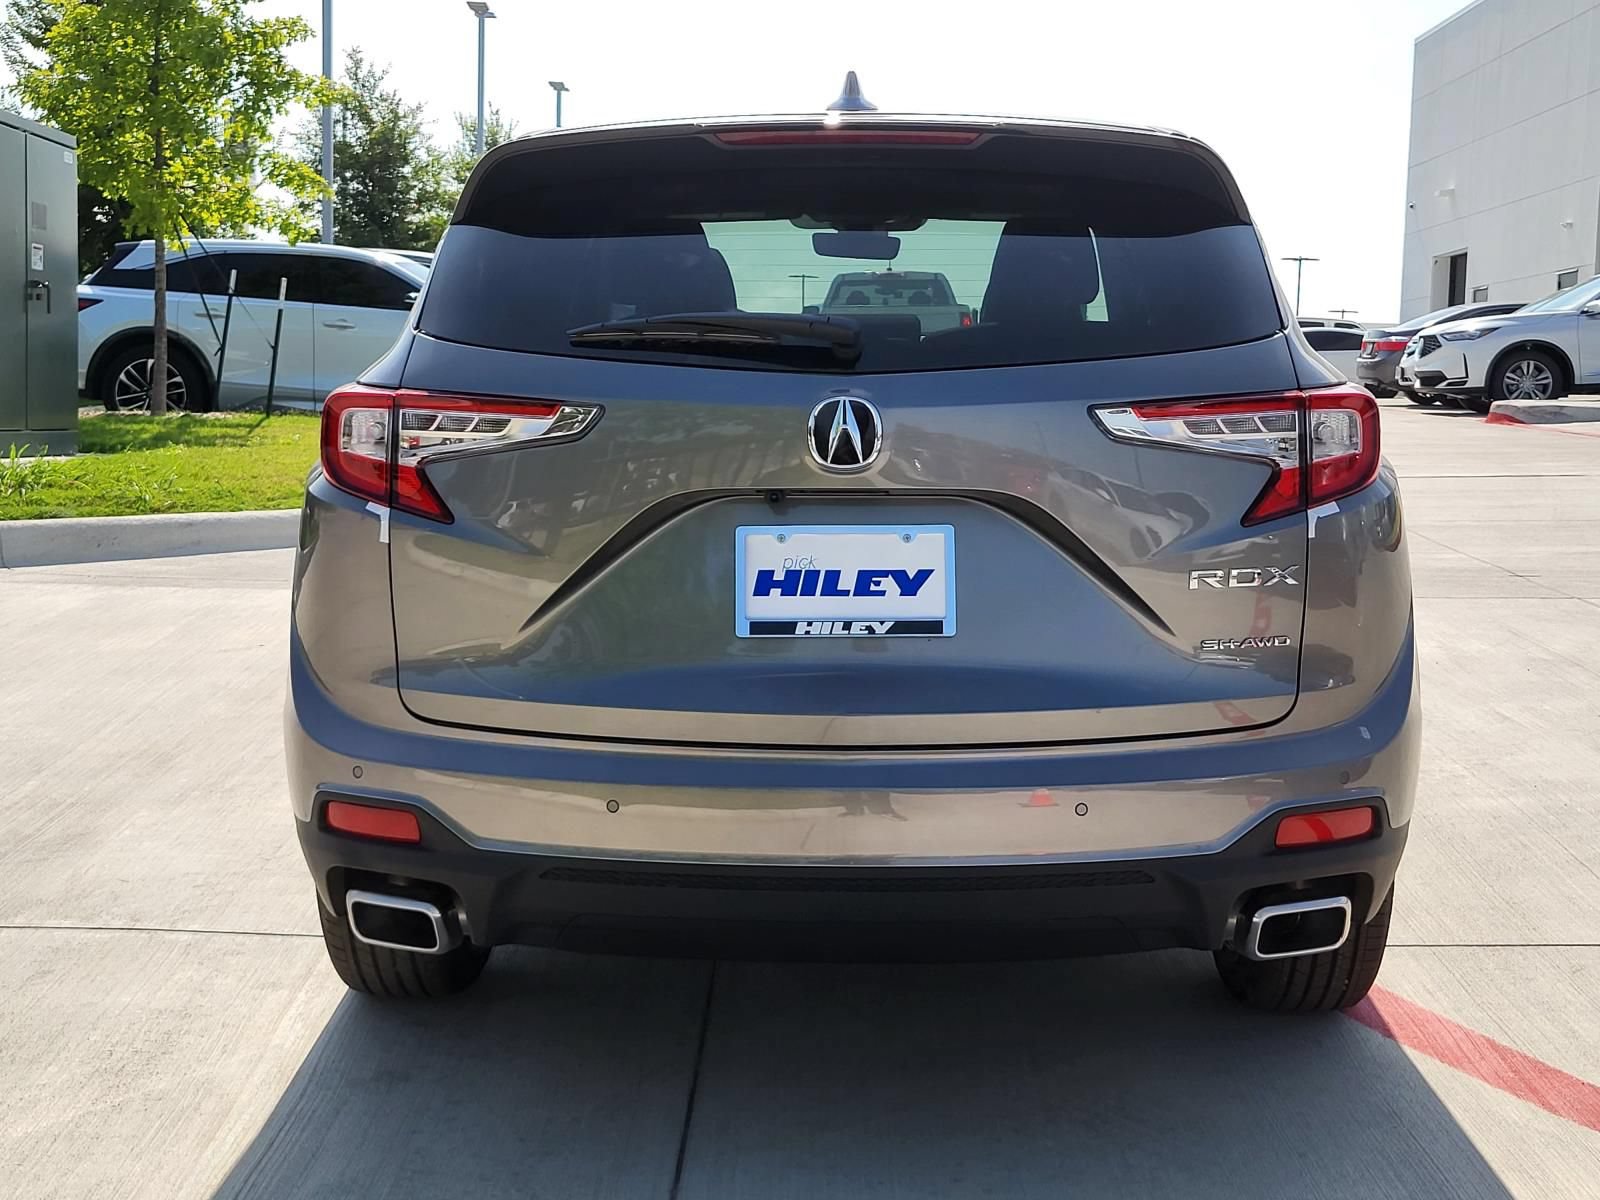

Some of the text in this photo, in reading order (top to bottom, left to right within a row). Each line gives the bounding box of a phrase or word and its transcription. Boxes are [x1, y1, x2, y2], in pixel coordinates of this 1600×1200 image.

[782, 555, 817, 570] pick
[752, 569, 936, 597] HILEY
[1189, 565, 1300, 590] RDX
[795, 621, 896, 635] HILEY
[1200, 636, 1291, 651] SH-AWD
